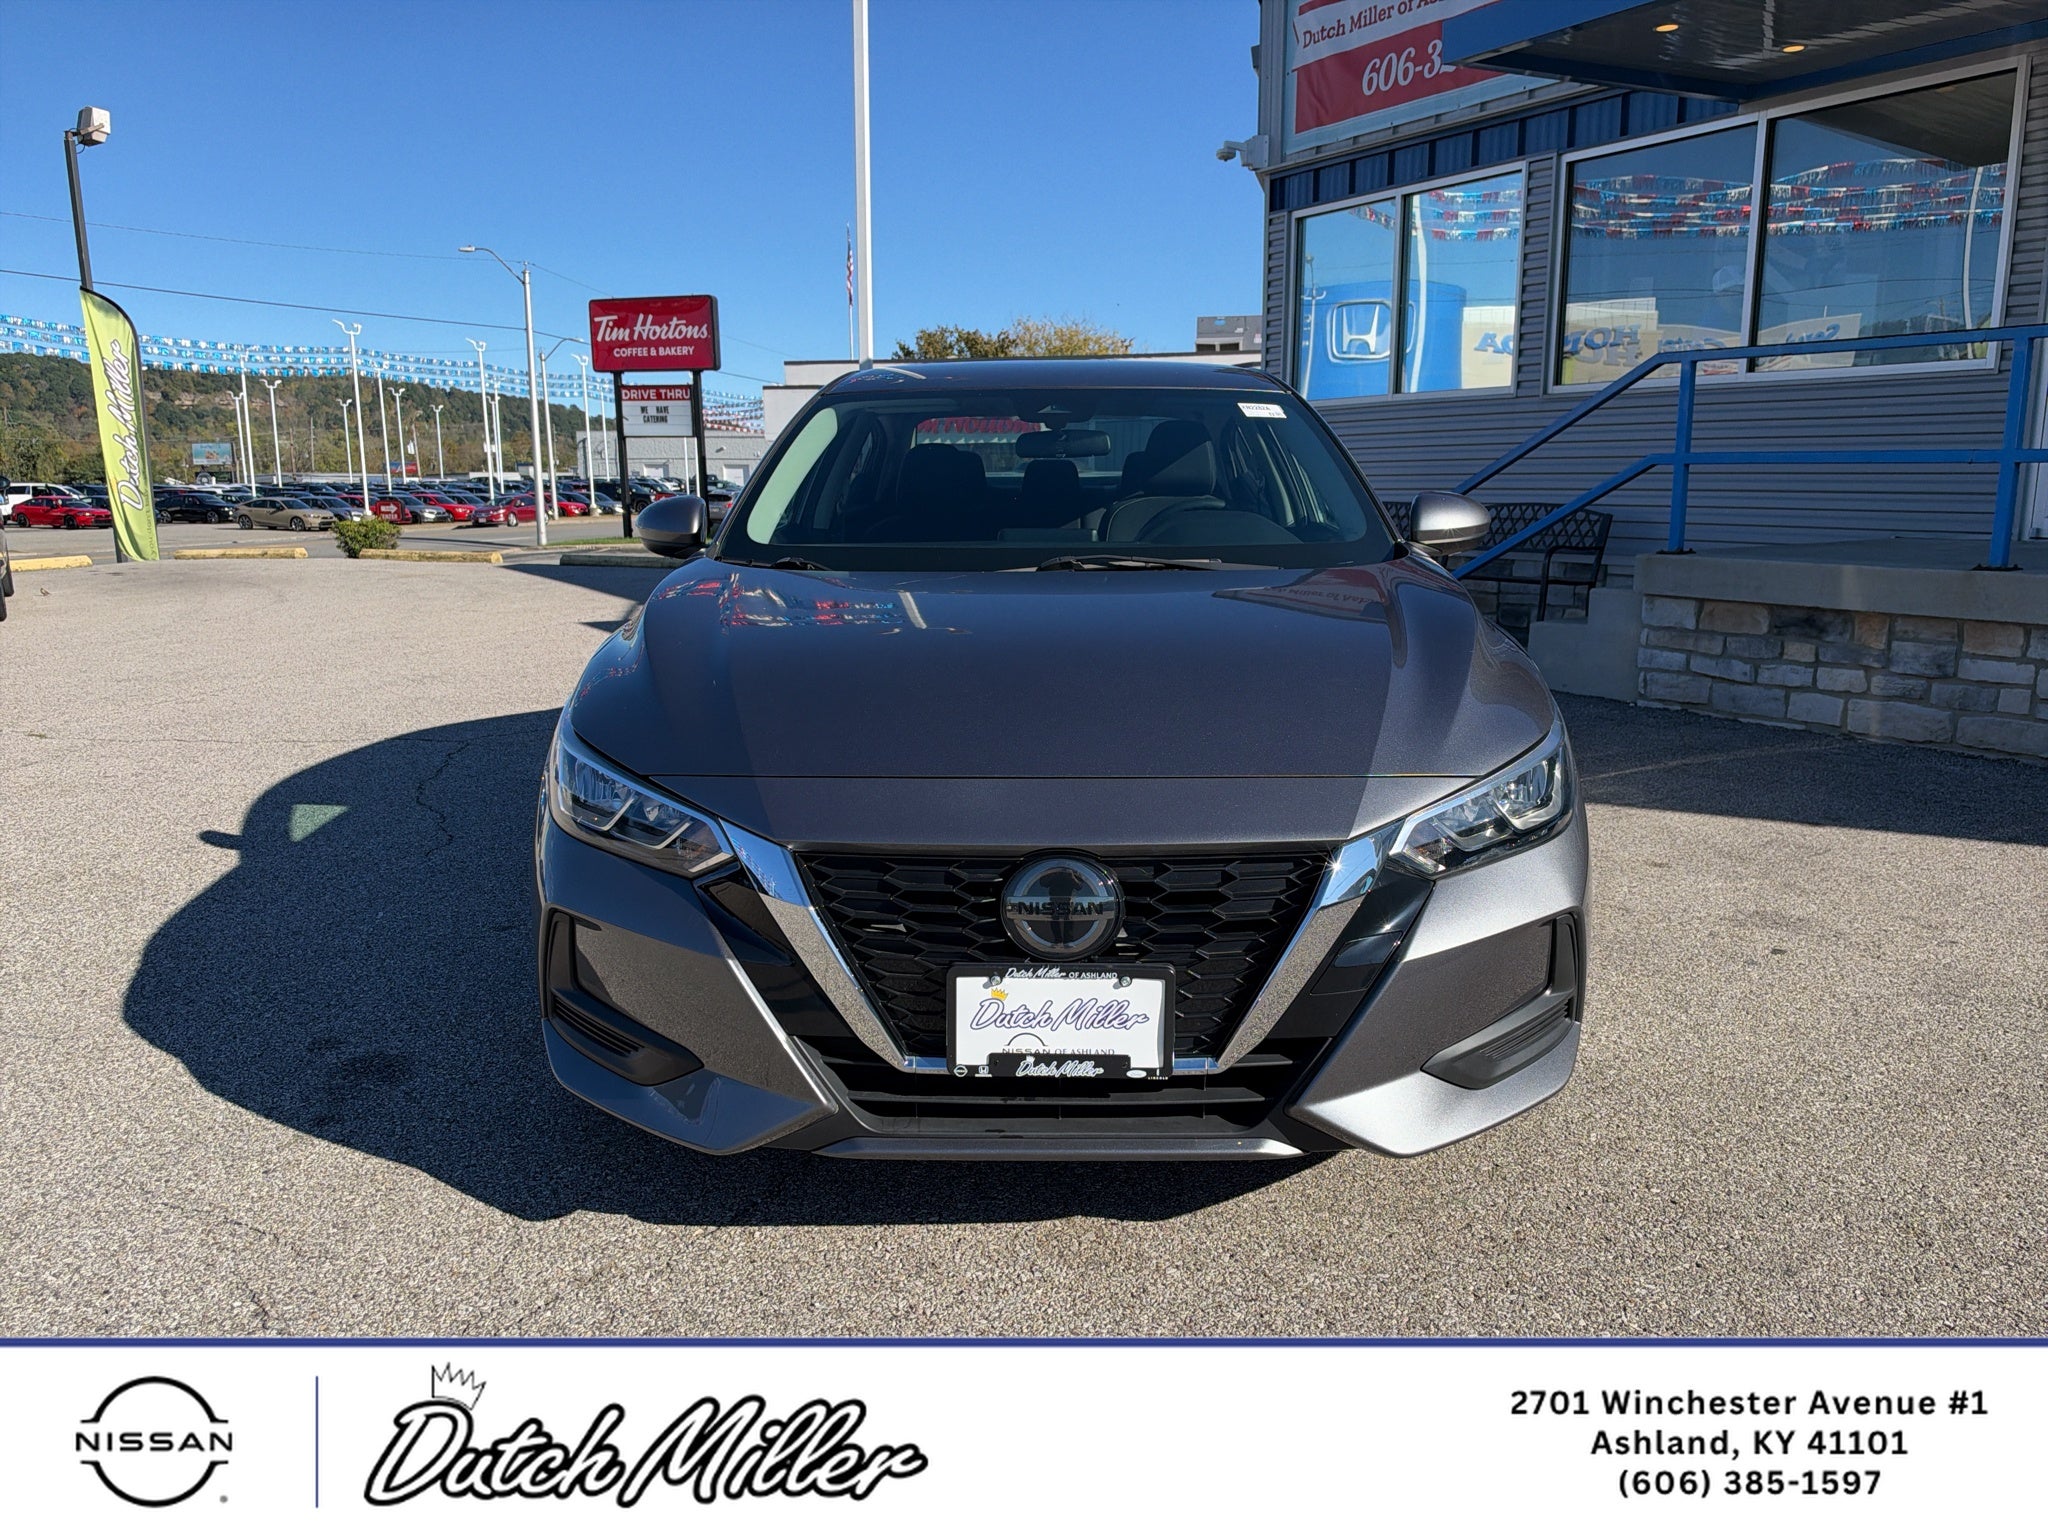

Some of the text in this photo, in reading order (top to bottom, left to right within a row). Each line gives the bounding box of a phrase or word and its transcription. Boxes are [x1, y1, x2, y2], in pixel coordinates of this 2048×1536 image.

[1303, 0, 1413, 48] Dutch Miller of
[1362, 39, 1457, 96] 606-3
[593, 312, 708, 342] Tim Hortons
[613, 346, 695, 358] COFFEE & BAKERY
[621, 388, 691, 400] DRIVE THRU
[640, 405, 669, 415] WE HAVE
[103, 338, 145, 511] Dutch Miller
[643, 415, 668, 424] CATERING
[1018, 901, 1104, 916] NISSAN
[1005, 967, 1034, 979] Dutch
[1034, 964, 1066, 979] Miller
[1080, 972, 1118, 980] ASHLAND
[970, 997, 1150, 1032] Dutch Miller
[1016, 1059, 1057, 1077] Dutch
[1054, 1059, 1105, 1078] Miller
